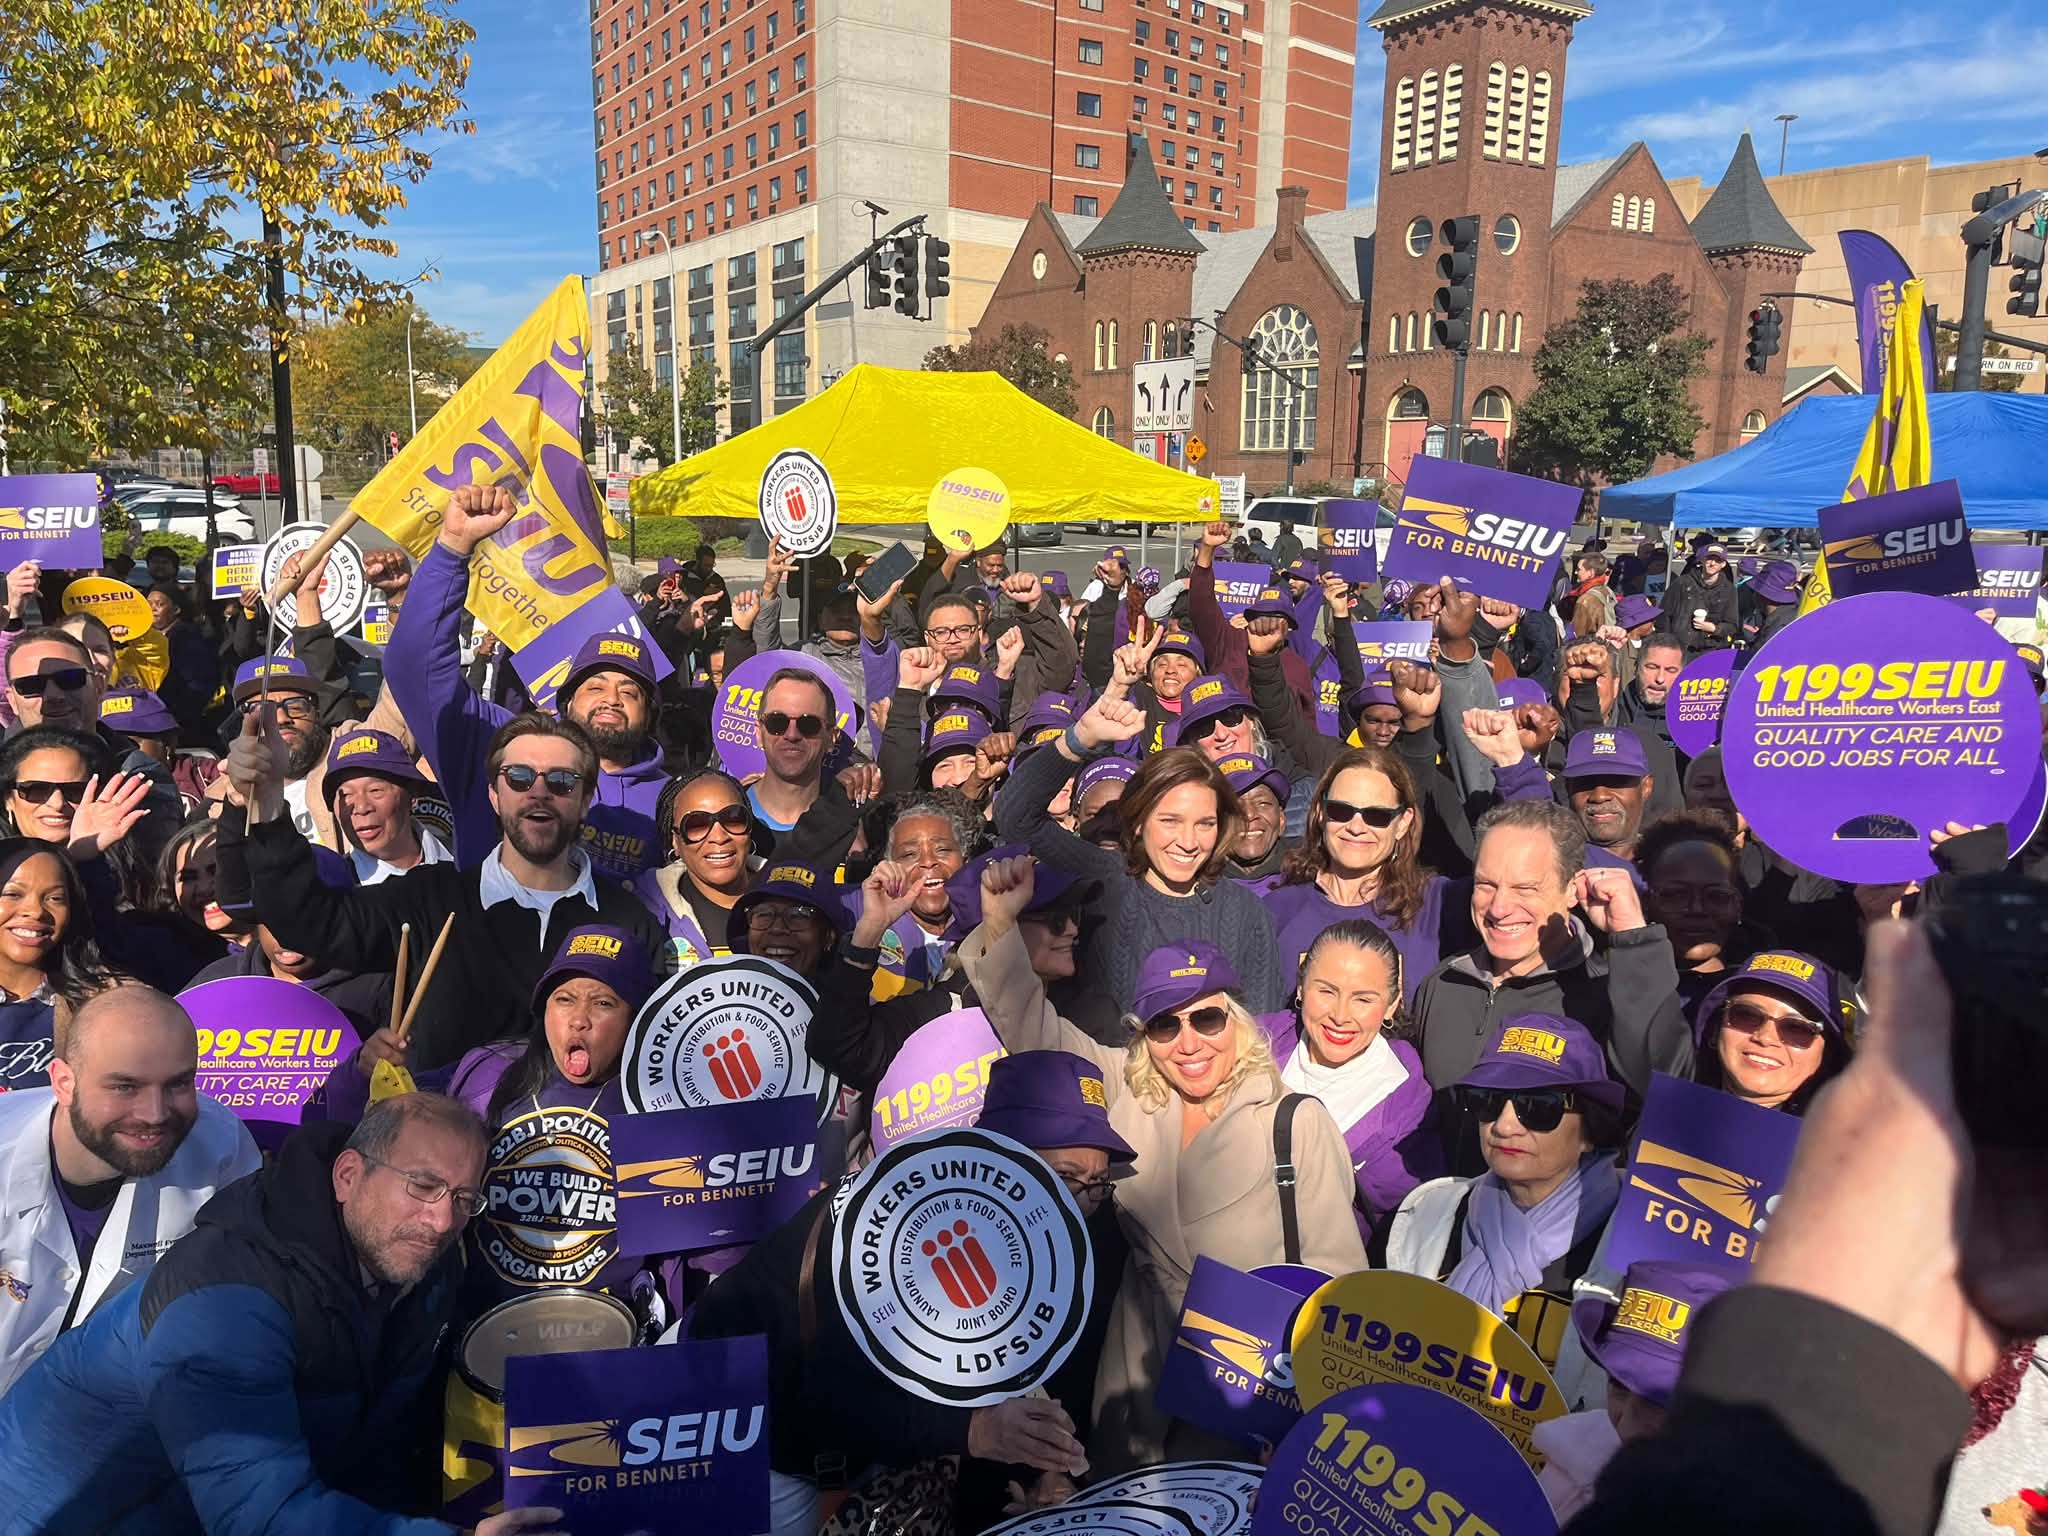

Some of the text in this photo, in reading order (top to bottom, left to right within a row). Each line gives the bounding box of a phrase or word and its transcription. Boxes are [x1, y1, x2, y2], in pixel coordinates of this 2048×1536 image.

[1998, 359, 2012, 370] ON
[2015, 359, 2034, 371] RED
[1136, 417, 1151, 426] ONLY
[1155, 415, 1171, 426] ONLY
[1175, 414, 1190, 425] ONLY
[1139, 443, 1150, 454] NO
[766, 463, 790, 507] WORKERS
[792, 462, 820, 485] UNITED
[941, 480, 1005, 503] 1199SEIU
[26, 506, 96, 529] SEIU
[401, 487, 444, 528] Stro
[1, 529, 71, 540] FOR BENNETT
[790, 524, 824, 546] LDFSJB
[1334, 528, 1376, 548] SEIU
[1467, 513, 1567, 557] SEIU
[1884, 518, 1963, 557] SEIU
[1406, 531, 1545, 573] FOR BENNETT
[1855, 551, 1937, 575] FOR BENNETT
[340, 554, 356, 609] LDFSJB
[470, 550, 553, 629] Togethe
[1228, 581, 1268, 597] SEI
[1980, 570, 2040, 588] SEIU
[69, 591, 134, 606] 1199SEIU
[1222, 596, 1256, 605] BENNET
[1973, 588, 2031, 598] BENNETT
[1382, 642, 1432, 658] SEIU
[1320, 680, 1341, 694] 119
[1680, 678, 1726, 695] 1199
[1754, 660, 2006, 701] 1199SEIU
[724, 704, 748, 716] United
[1320, 692, 1338, 705] SE
[1679, 704, 1722, 712] QUALITY
[1755, 700, 2001, 717] United Healthcare Workers East
[720, 718, 757, 736] QUALI
[1679, 712, 1720, 721] GOOD JO
[717, 730, 752, 746] GOOD
[1754, 726, 2003, 746] QUALITY CARE AND
[1753, 748, 1999, 768] GOOD JOBS FOR ALL
[413, 803, 454, 823] POLITIC
[769, 866, 816, 885] SEIU
[570, 935, 623, 954] SEIU
[196, 1028, 342, 1058] 99SEIU
[648, 981, 795, 1086] WORKERS UNITED
[682, 1012, 731, 1063] DISTRIBUTION
[735, 1012, 742, 1021] &
[744, 1013, 768, 1032] FOOD
[766, 1030, 784, 1069] SERVICE
[1501, 1028, 1566, 1056] SEIU
[260, 1056, 310, 1068] Workers
[314, 1056, 338, 1068] East
[238, 1077, 290, 1090] CARE
[295, 1077, 326, 1090] AN
[874, 1048, 1009, 1128] 1199SE
[214, 1093, 326, 1106] OBS FOR AL
[650, 1092, 673, 1111] SEIU
[883, 1119, 919, 1139] United
[920, 1097, 977, 1122] Healthcare
[491, 1115, 612, 1160] 32BJ POLITIC
[554, 1139, 586, 1154] OLITICAL
[584, 1146, 608, 1170] POWER
[706, 1143, 815, 1187] SEIU
[514, 1170, 602, 1192] WE BUILD
[488, 1186, 616, 1223] POWER
[663, 1182, 775, 1208] FOR BENNETT
[519, 1214, 584, 1227] 32BJ SEIU
[861, 1160, 1028, 1294] WORKERS UNITED
[1645, 1200, 1713, 1246] FOR
[490, 1240, 607, 1281] ORGANIZERS
[524, 1246, 562, 1260] WORKING
[562, 1242, 589, 1258] PEOPLE
[900, 1198, 1022, 1322] LAUNDRY, DISTRIBUTION & FOOD SERVICE
[956, 1286, 1018, 1331] JOINT BOARD
[1618, 1288, 1690, 1330] SEIU
[872, 1302, 1056, 1374] SEIU LDFSJB
[1320, 1304, 1546, 1411] 1199SEIU
[1321, 1334, 1538, 1426] United Healthcare Workers Eas
[1322, 1356, 1380, 1385] QUAL
[1215, 1366, 1249, 1391] FOR
[1254, 1382, 1301, 1412] BENN
[1322, 1375, 1350, 1393] GO
[622, 1404, 765, 1466] SEIU
[565, 1461, 713, 1494] FOR BENNETT
[1314, 1412, 1503, 1536] 1199SE
[1306, 1447, 1419, 1536] United Healthca
[1282, 1502, 1332, 1536] GOO
[1294, 1479, 1382, 1536] QUALIT
